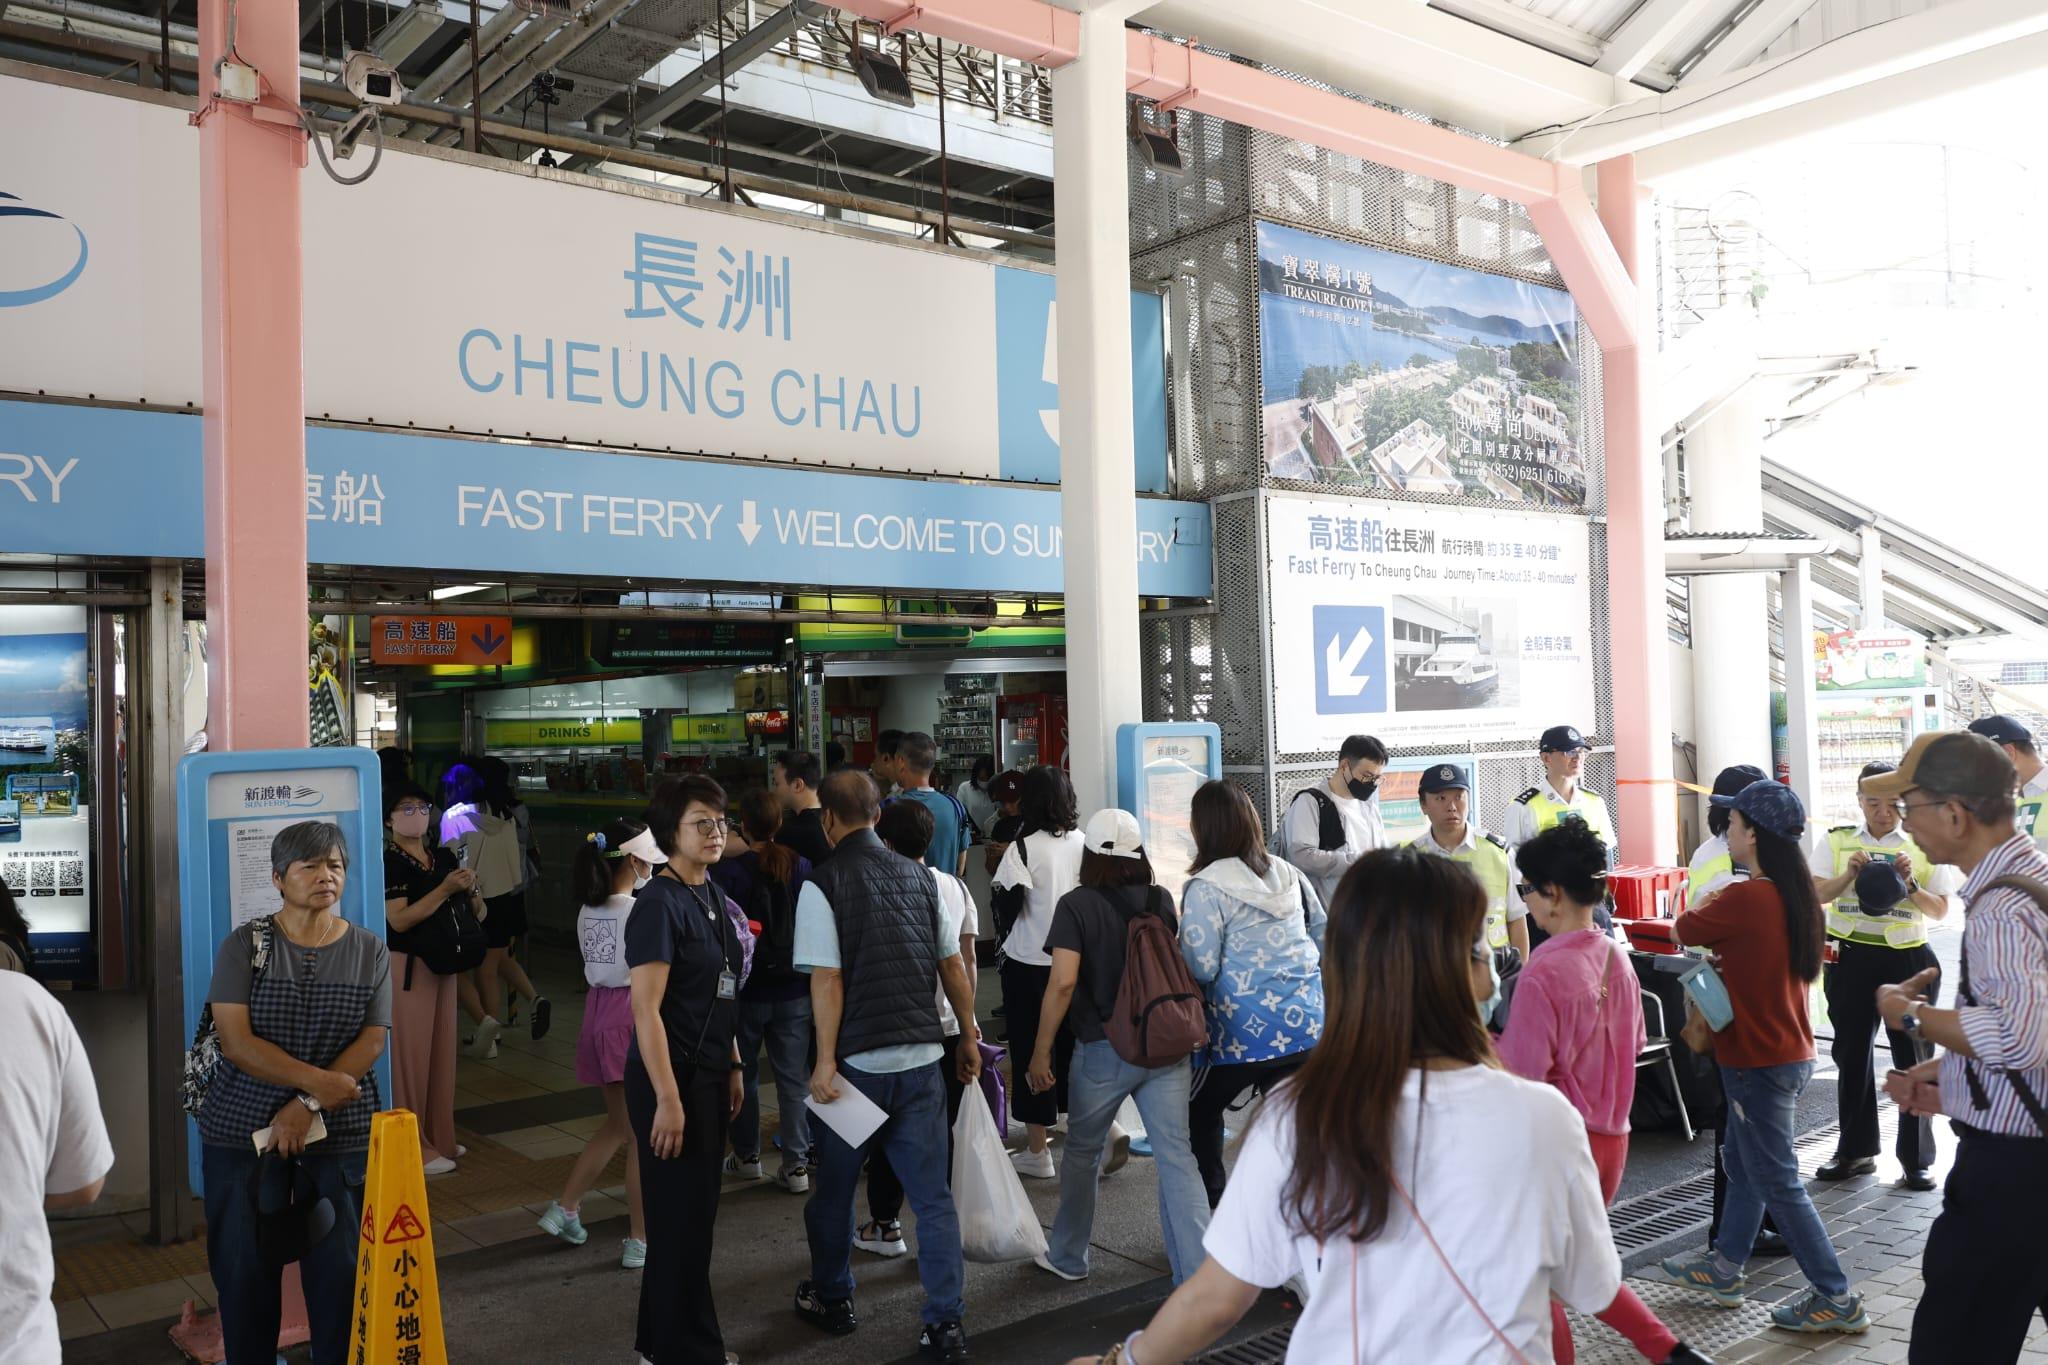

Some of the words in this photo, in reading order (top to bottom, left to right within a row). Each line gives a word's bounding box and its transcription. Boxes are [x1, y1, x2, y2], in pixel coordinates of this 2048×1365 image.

[624, 232, 791, 340] 長洲
[1284, 284, 1337, 308] TREASURE
[458, 328, 745, 419] CHEUNG
[771, 368, 921, 438] CHAU
[458, 485, 573, 532] FAST
[583, 495, 723, 540] FERRY
[773, 507, 955, 553] WELCOME
[961, 520, 1006, 555] TO
[1288, 555, 1318, 574] Fast
[1322, 557, 1356, 580] Ferry
[1360, 563, 1372, 576] To
[1375, 563, 1411, 580] Cheung
[1414, 565, 1437, 578] Chau
[1443, 568, 1475, 583] Journey
[384, 620, 457, 641] 高速船
[384, 643, 416, 655] FAST
[419, 644, 457, 656] FERRY
[538, 726, 591, 738] DRINKS
[697, 723, 726, 735] DRINKS
[245, 785, 292, 801] 新渡輪
[264, 799, 290, 808] FERRY
